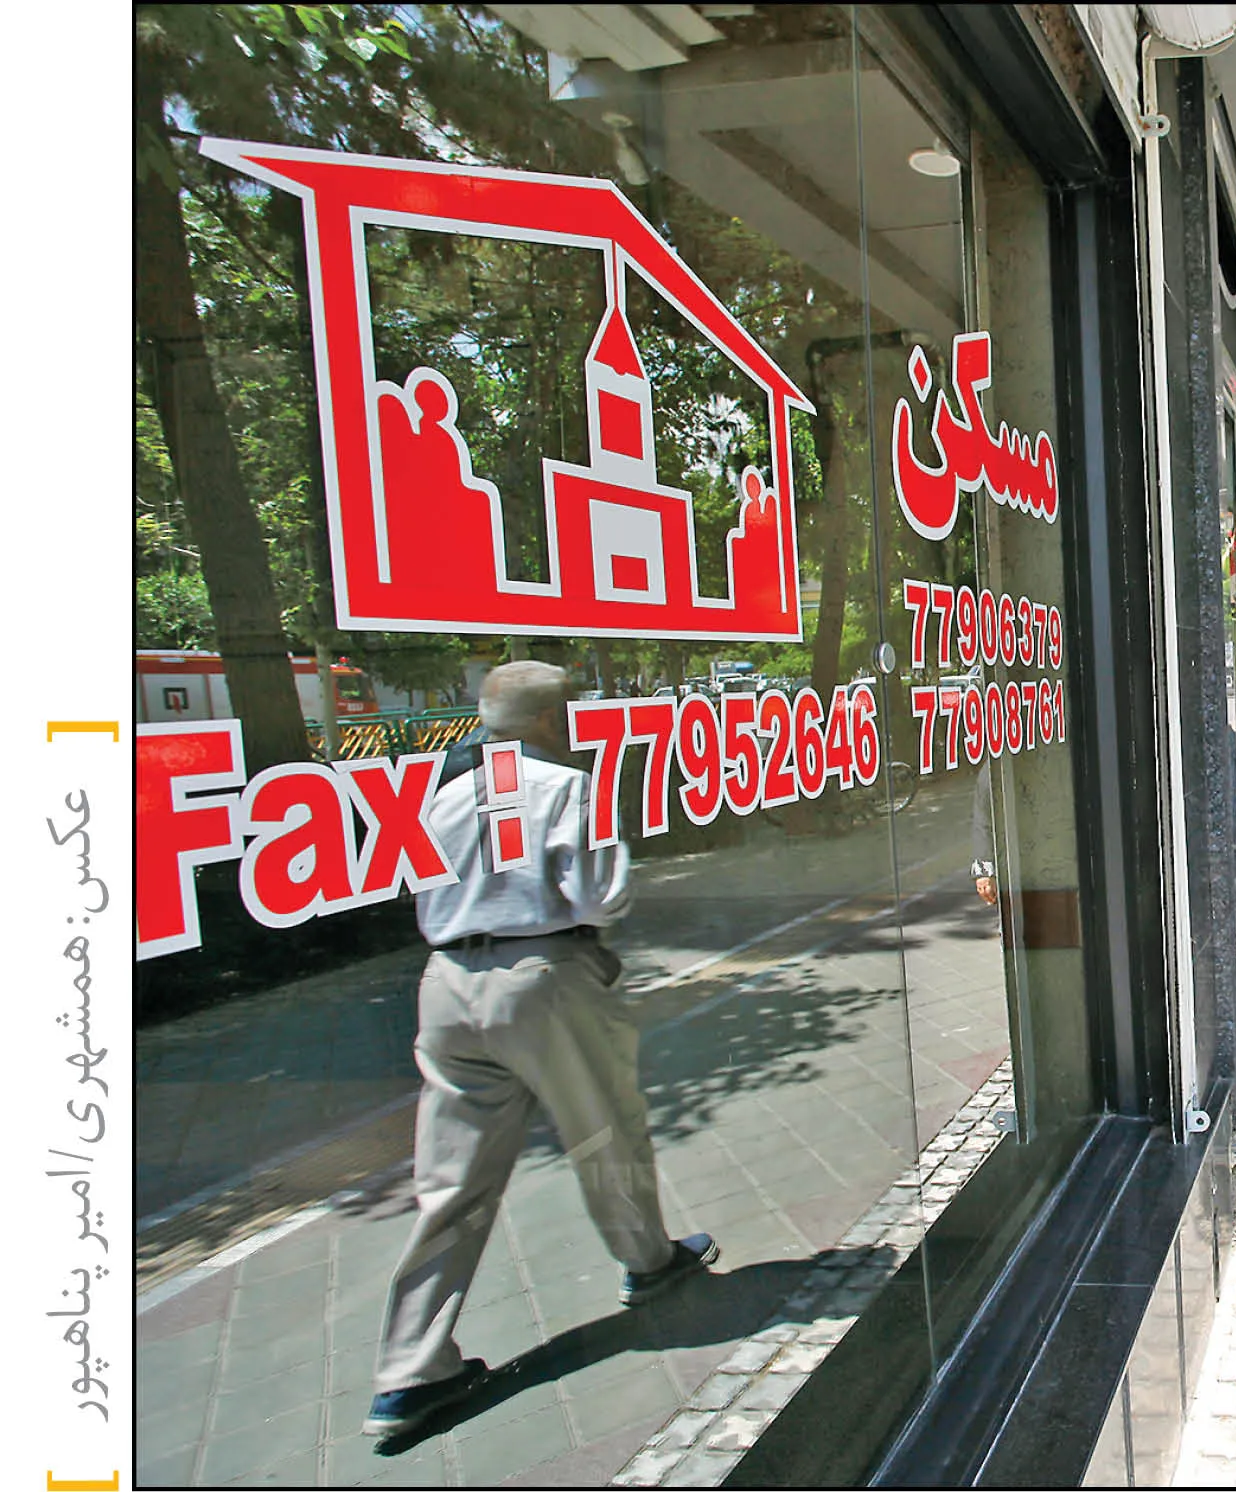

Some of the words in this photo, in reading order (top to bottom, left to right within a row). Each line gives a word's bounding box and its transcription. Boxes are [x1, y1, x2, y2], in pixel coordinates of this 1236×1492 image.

[892, 330, 1059, 541] مسکن
[904, 578, 1063, 670] 77906379
[567, 684, 880, 851] 77952646
[912, 678, 1065, 775] 77908761
